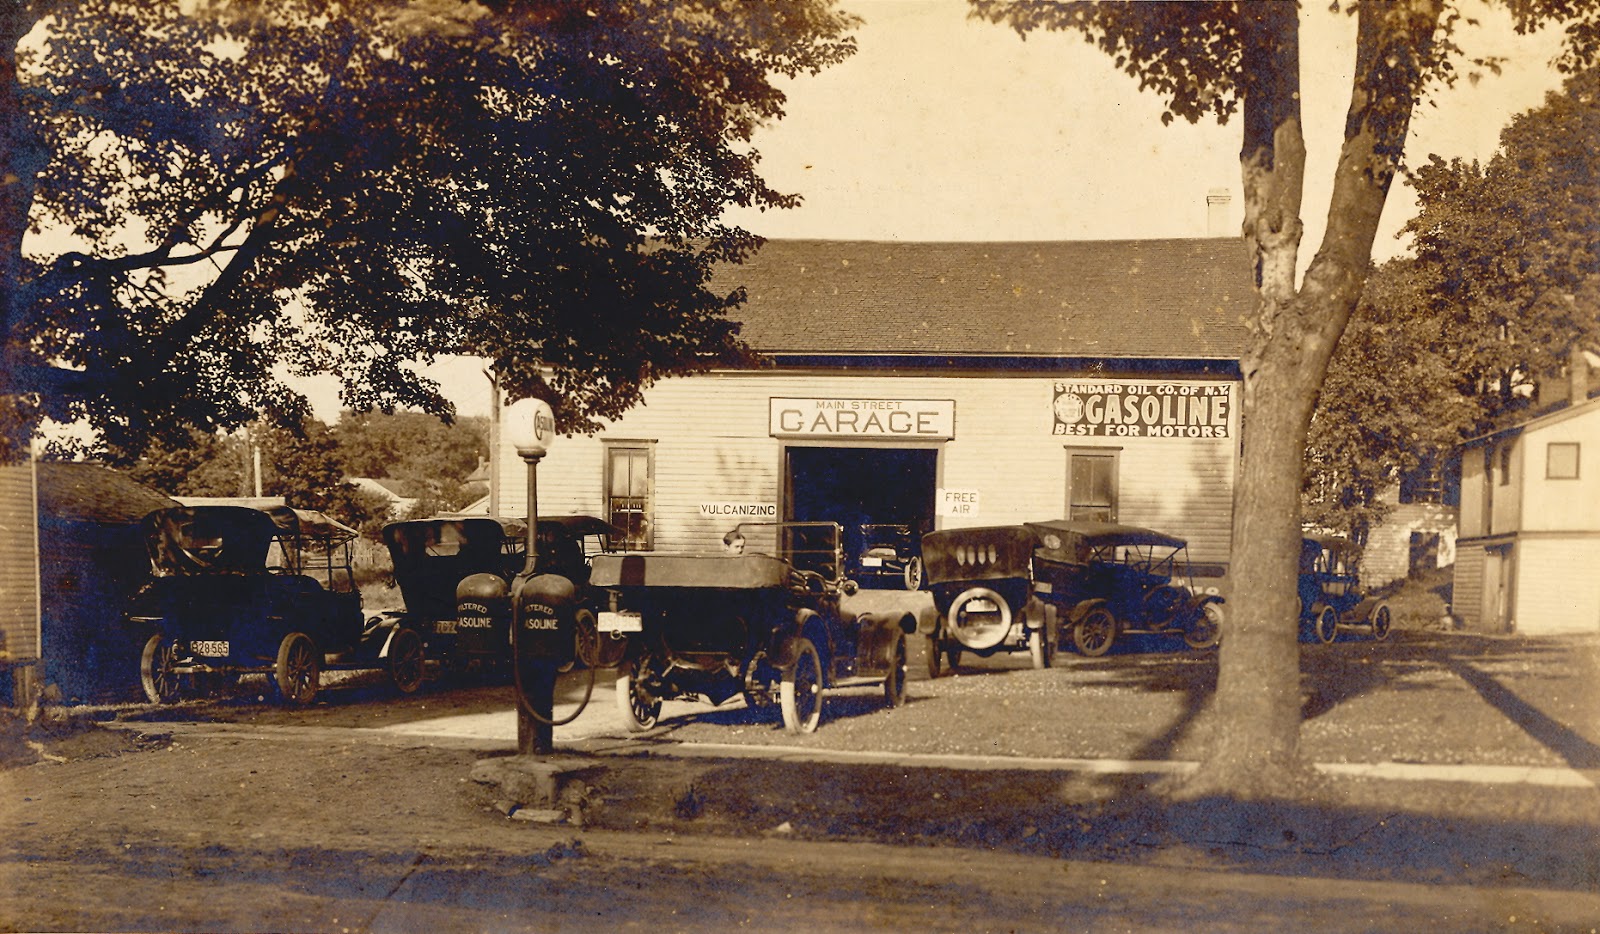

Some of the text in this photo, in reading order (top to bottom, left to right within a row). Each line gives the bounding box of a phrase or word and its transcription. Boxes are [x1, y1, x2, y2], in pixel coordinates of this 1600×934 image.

[1055, 383, 1122, 394] STANDARD
[1128, 385, 1151, 395] OIL
[1179, 386, 1198, 395] OF
[1204, 386, 1229, 396] N.Y.
[816, 401, 903, 411] MAIN STREET
[1085, 395, 1227, 425] GASOLINE
[780, 409, 940, 434] GARAGE
[1054, 424, 1227, 438] BEST FOR MOTORS
[945, 492, 977, 503] FREE
[701, 504, 776, 516] VULCANIZING
[951, 504, 971, 514] AIR
[458, 617, 492, 628] ASOLINE
